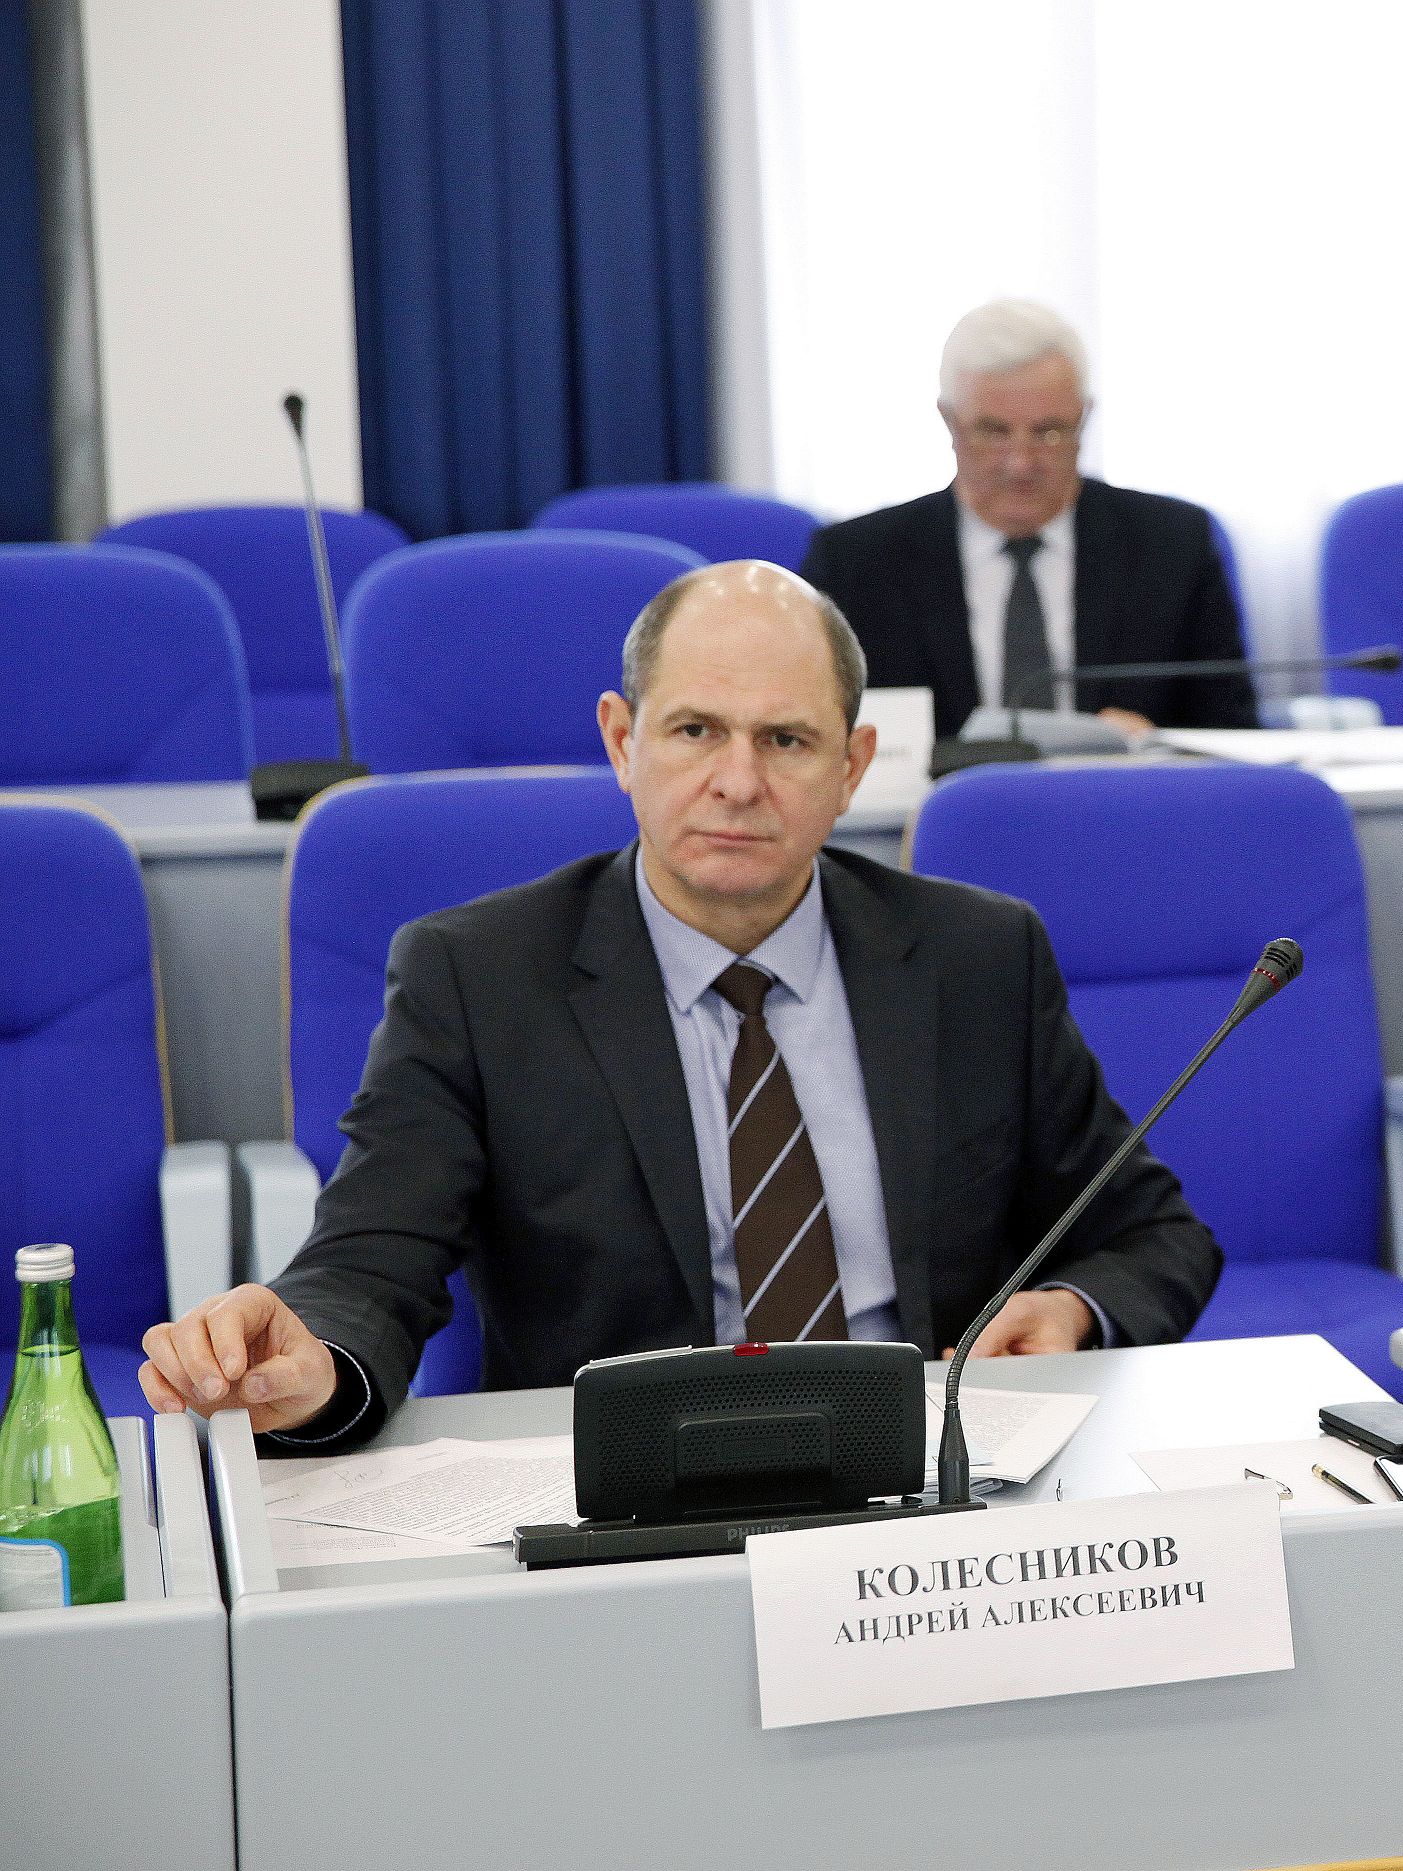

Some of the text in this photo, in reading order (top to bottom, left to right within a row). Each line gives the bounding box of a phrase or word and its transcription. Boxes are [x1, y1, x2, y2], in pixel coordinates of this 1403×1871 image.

[855, 1535, 1180, 1603] КОЛЕСНИКОВ
[832, 1580, 1207, 1646] АНДРЕЙ АЛЕКСЕЕВИЧ
